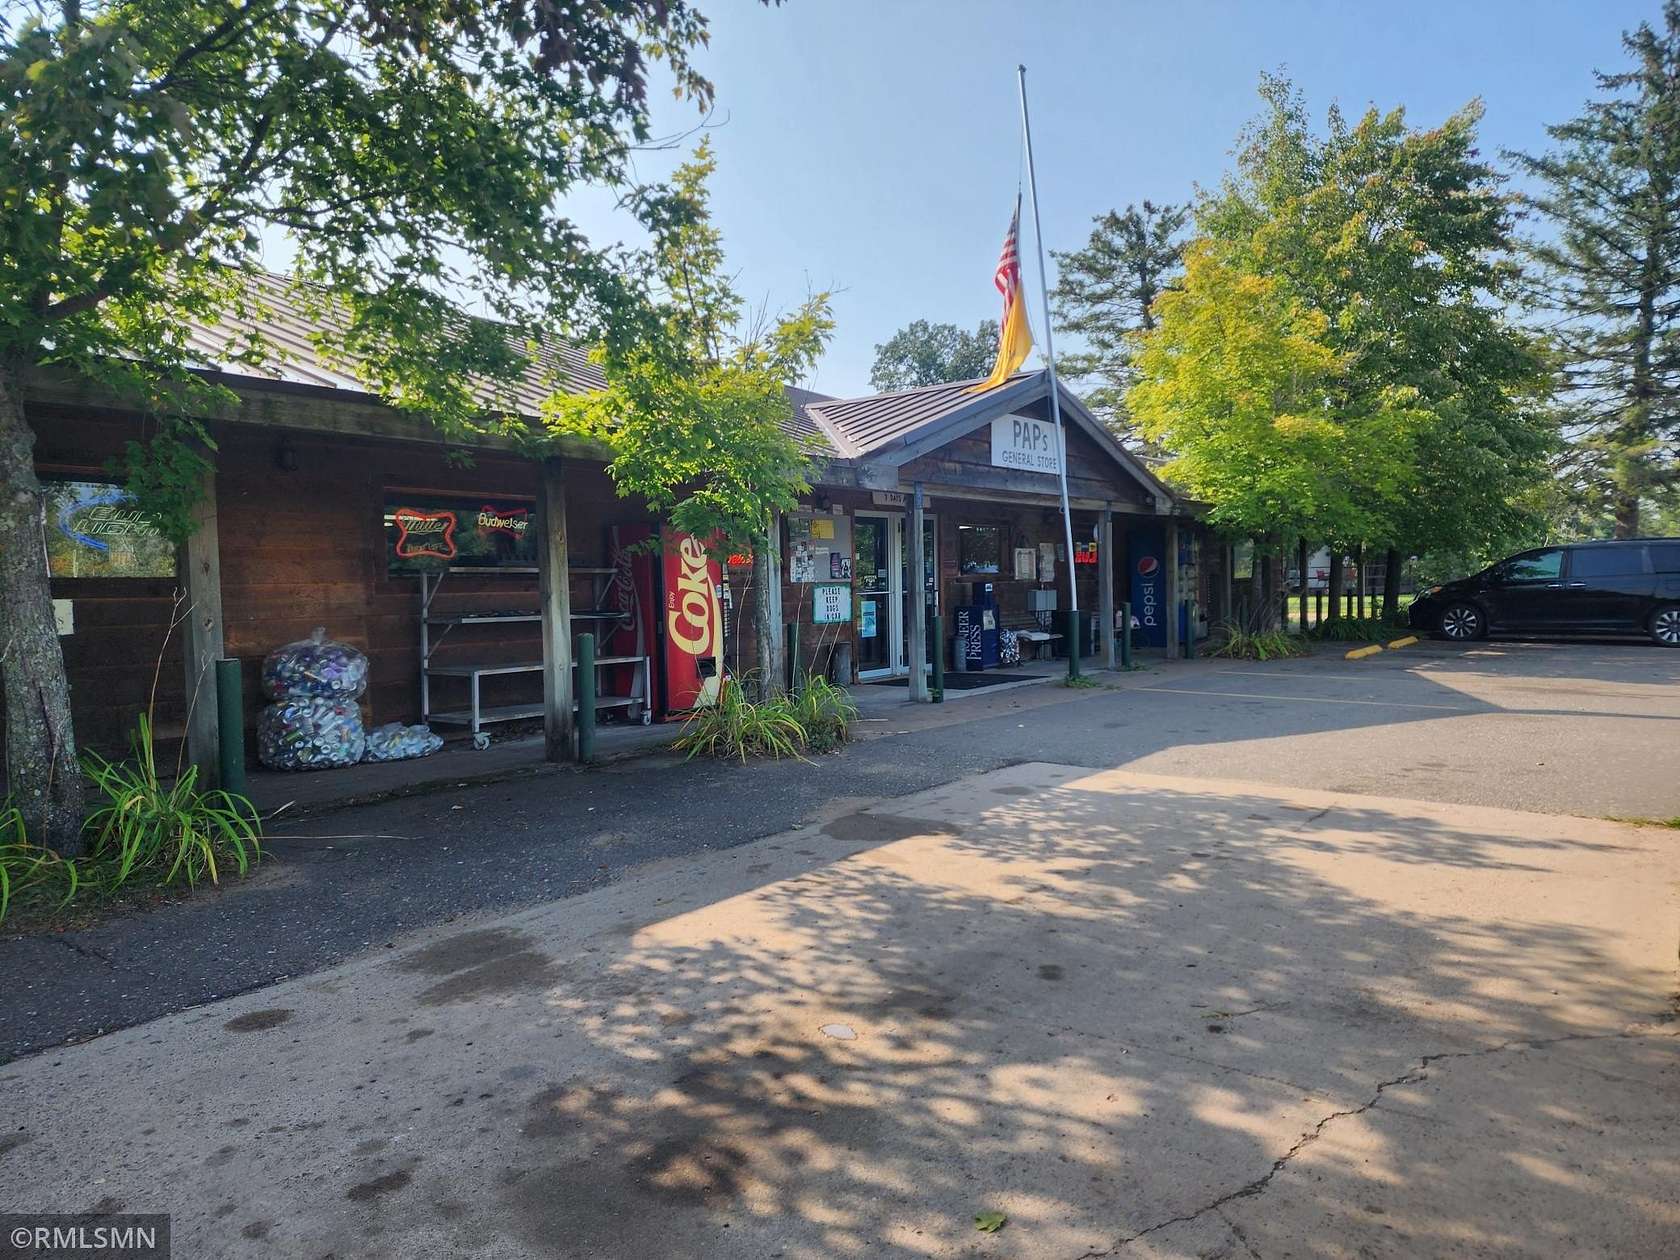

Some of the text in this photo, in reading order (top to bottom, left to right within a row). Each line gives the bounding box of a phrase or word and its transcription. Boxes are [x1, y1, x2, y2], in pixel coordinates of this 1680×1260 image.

[1001, 450, 1057, 470] GENERAL STORE
[478, 512, 528, 530] Budweiser
[668, 536, 710, 655] Coke
[668, 591, 676, 608] Enjoy
[822, 587, 841, 595] PLEASE
[826, 604, 839, 612] DOGS
[1141, 583, 1157, 626] pepsi
[966, 625, 981, 659] PRESS
